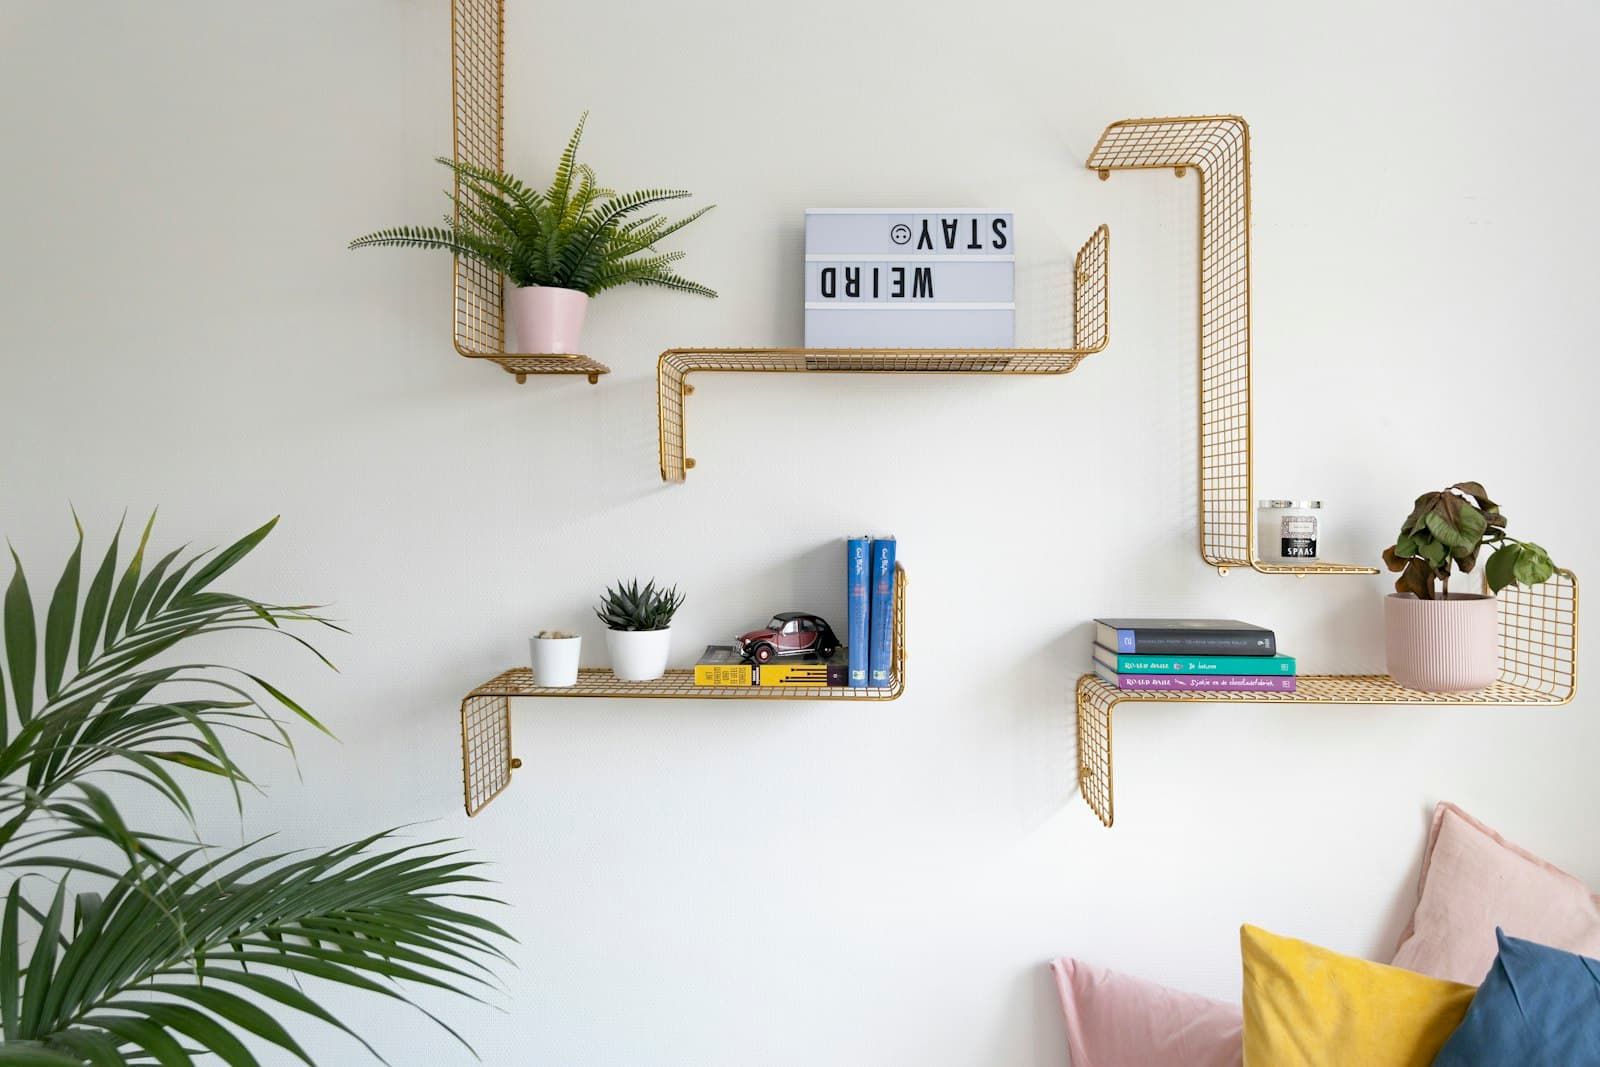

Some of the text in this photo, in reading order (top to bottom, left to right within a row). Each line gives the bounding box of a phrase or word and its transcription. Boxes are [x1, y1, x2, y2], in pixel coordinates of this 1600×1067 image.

[917, 218, 1007, 250] STAY
[821, 267, 934, 298] WEIRD
[1287, 547, 1314, 556] SPAAS
[1124, 662, 1149, 670] ROALD
[1126, 678, 1151, 686] ROALD
